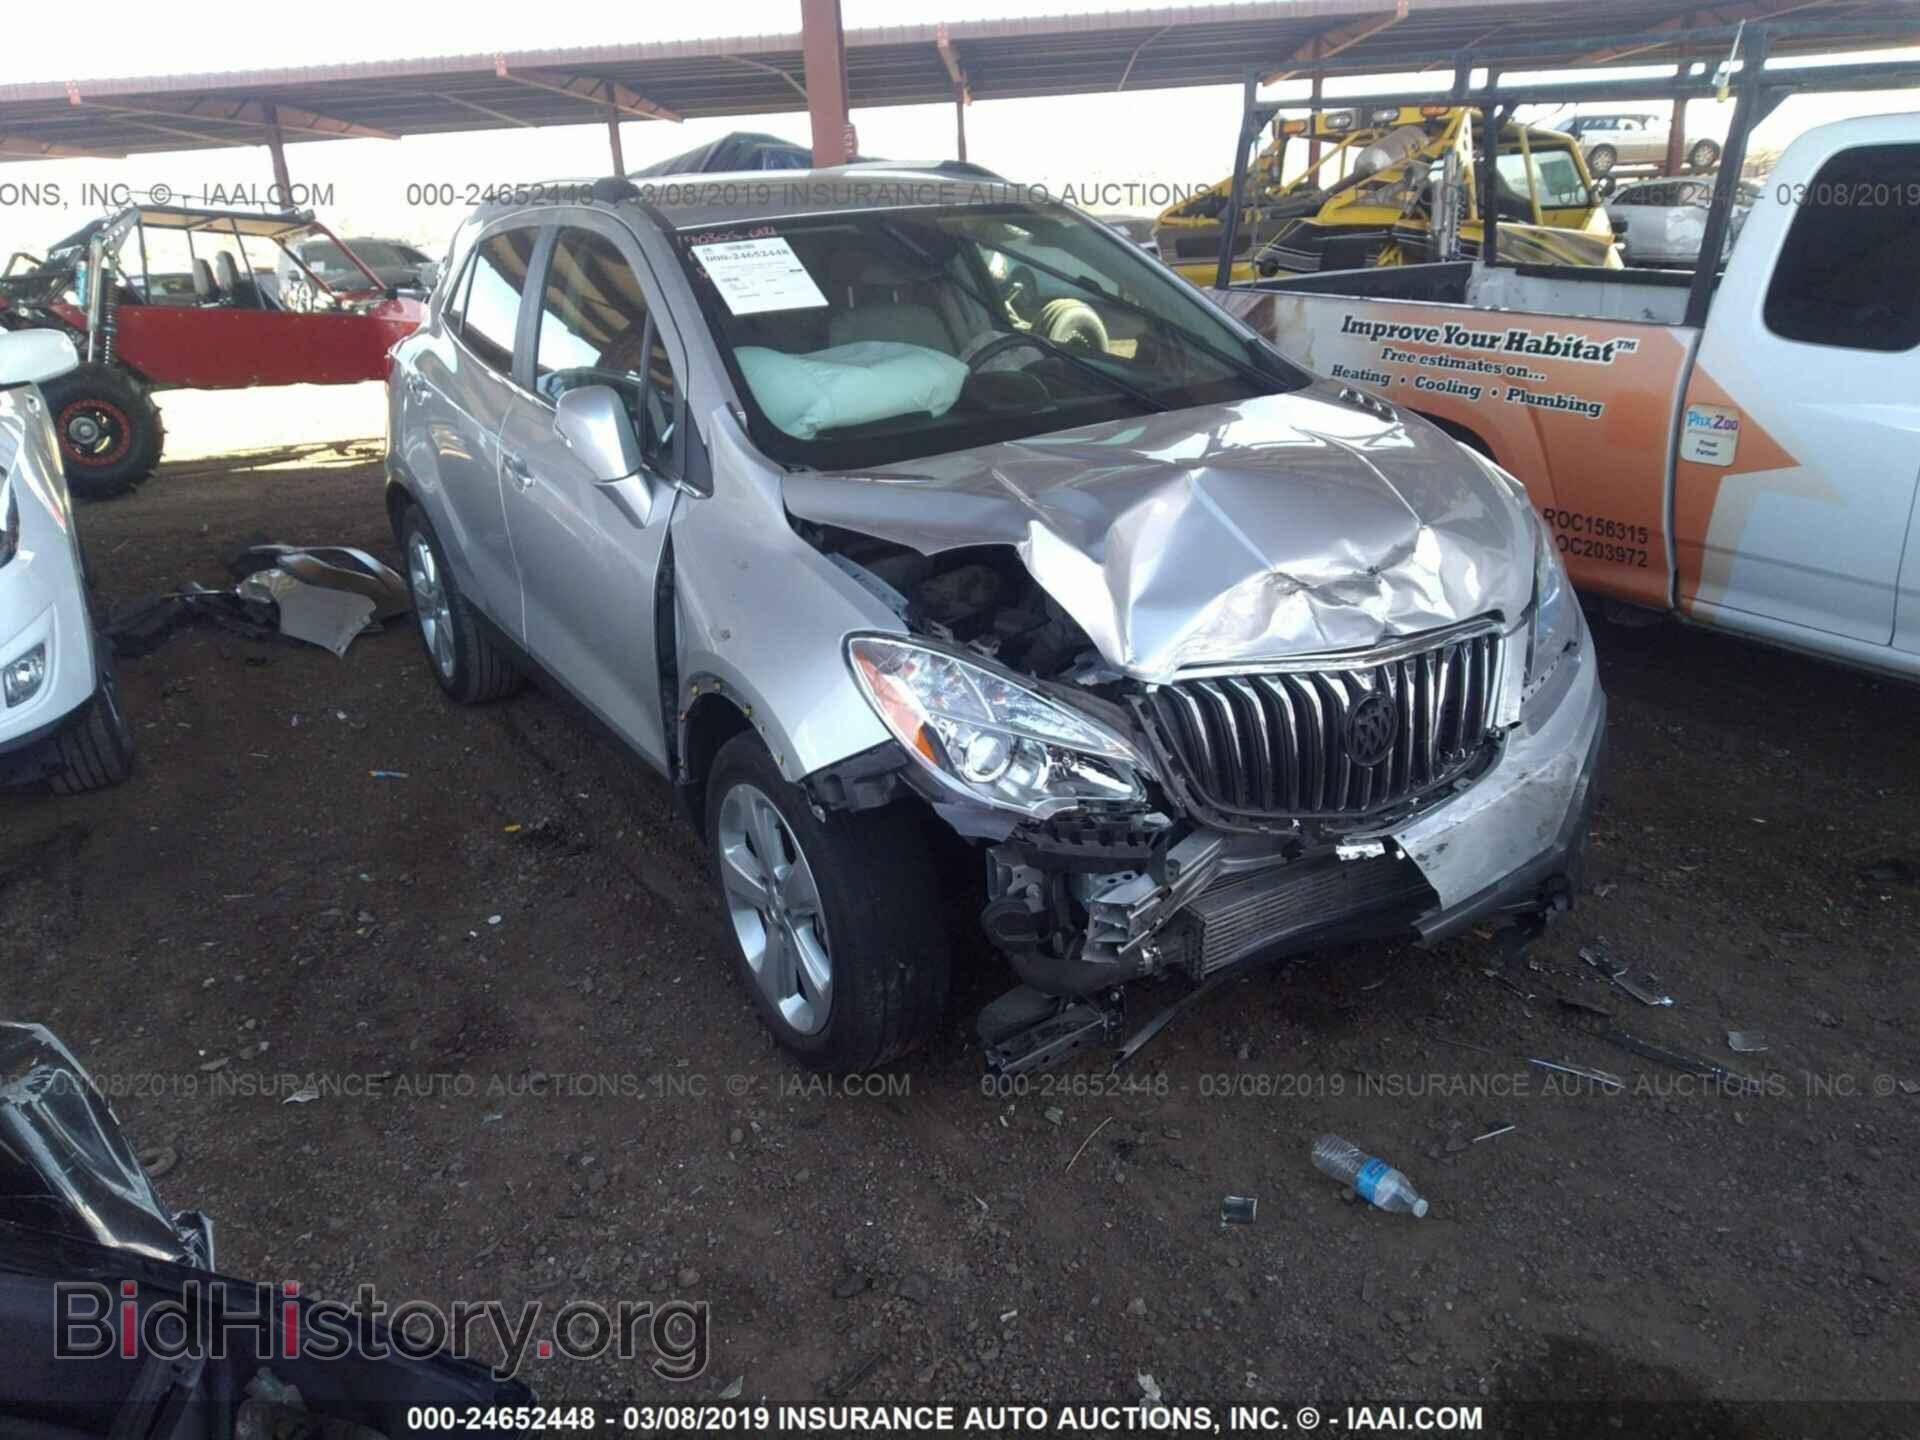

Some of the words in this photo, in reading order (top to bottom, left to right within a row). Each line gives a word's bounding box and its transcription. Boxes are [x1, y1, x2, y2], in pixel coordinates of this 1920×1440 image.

[1340, 314, 1439, 343] Improve
[1443, 324, 1502, 351] Your
[1380, 347, 1417, 364] Free
[1418, 355, 1502, 375] estimates
[1331, 364, 1392, 387] Heating
[1414, 375, 1482, 401] Cooling
[1506, 387, 1604, 418] Plumbing
[1543, 508, 1648, 544] ROC156315
[1555, 534, 1648, 568] OC203972
